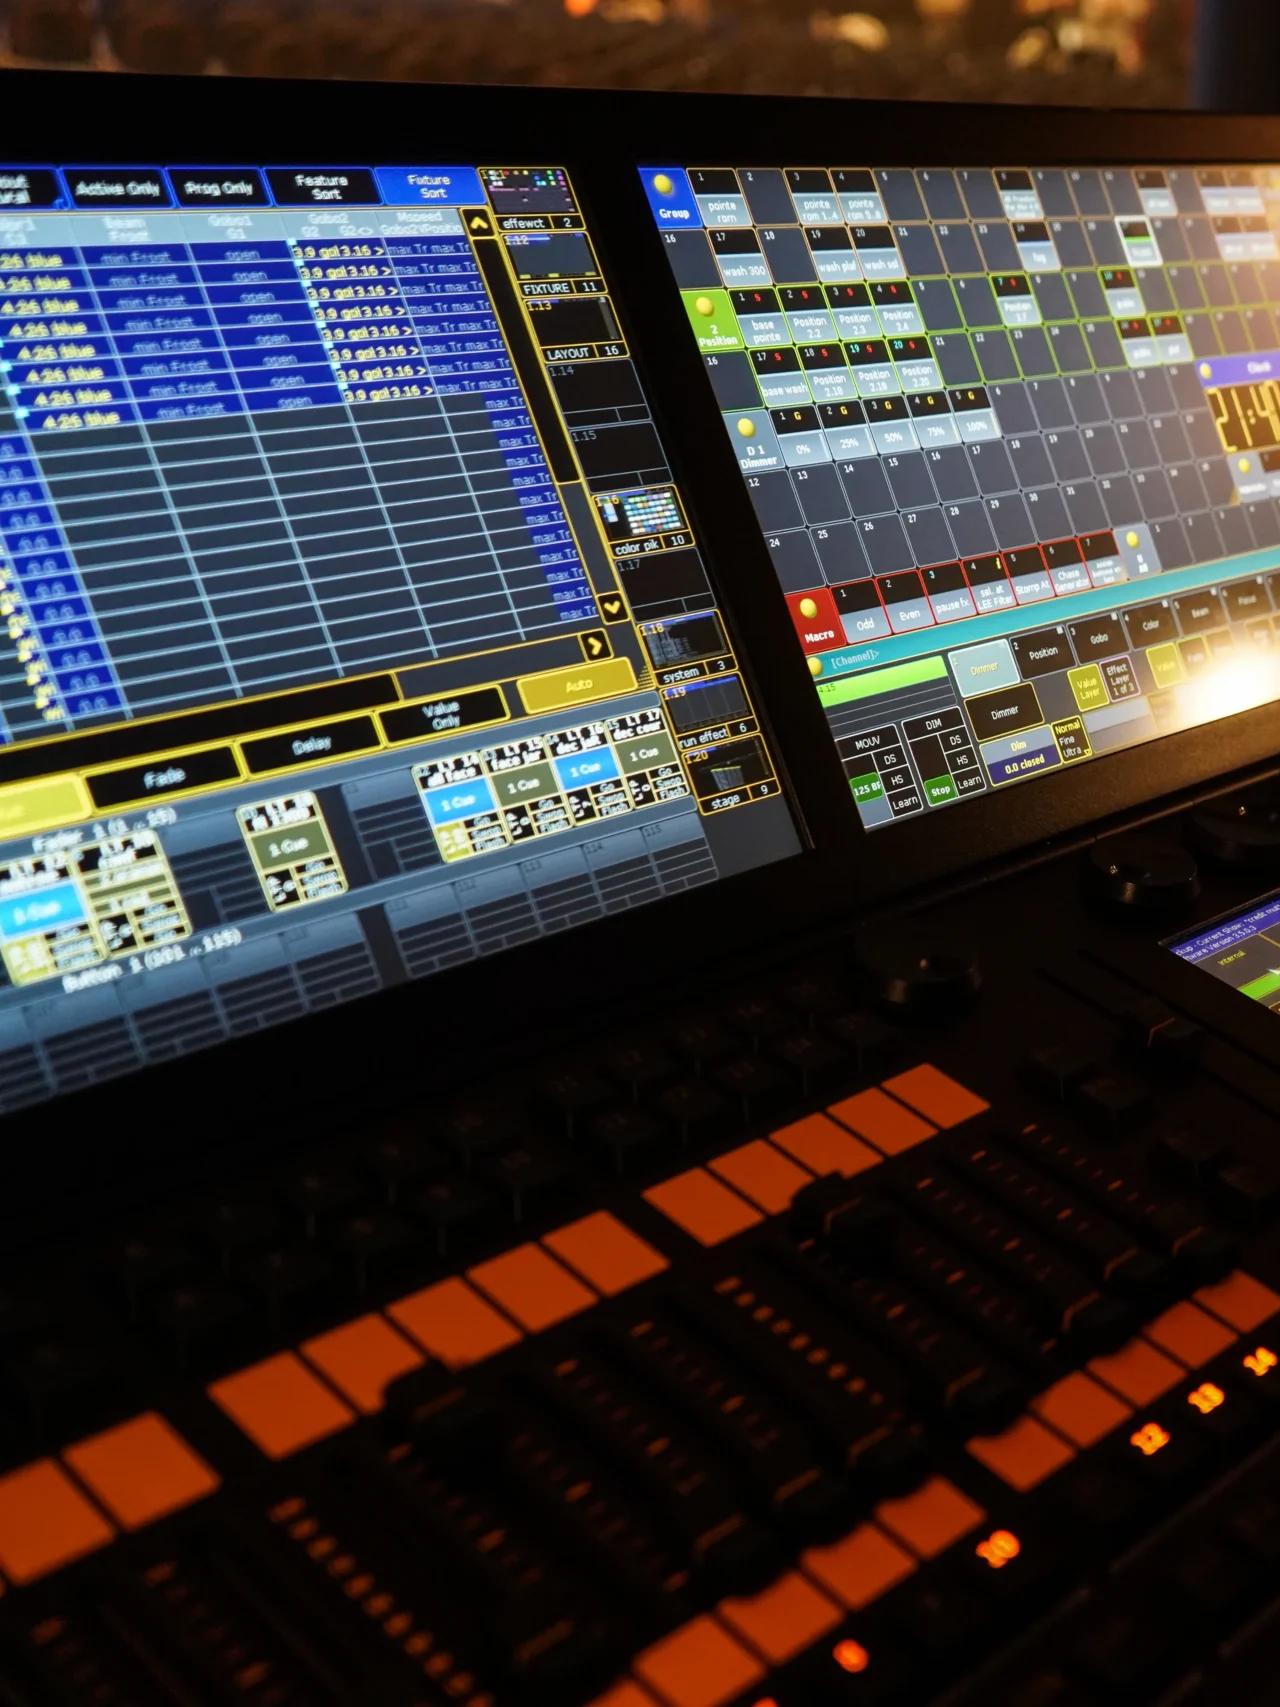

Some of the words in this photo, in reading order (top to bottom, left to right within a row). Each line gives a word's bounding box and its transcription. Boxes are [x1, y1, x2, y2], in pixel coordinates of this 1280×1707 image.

[295, 174, 348, 187] Feature
[407, 174, 451, 186] Fixture
[76, 180, 125, 196] Active
[126, 181, 160, 197] Only
[184, 181, 221, 196] Prog
[221, 181, 253, 197] Only
[311, 187, 342, 200] Sort
[420, 187, 448, 199] Sort
[708, 201, 737, 213] pointe
[803, 200, 830, 210] pointe
[848, 199, 874, 209] pointe
[659, 208, 690, 220] Group
[717, 214, 737, 223] rom
[802, 212, 819, 222] rom
[847, 210, 864, 220] rom
[503, 218, 546, 230] effewct
[563, 218, 572, 227] 2
[665, 233, 677, 243] 16
[716, 232, 726, 242] 17
[764, 231, 775, 241] 18
[811, 230, 821, 239] 19
[818, 261, 841, 273] wash
[864, 259, 885, 270] wash
[723, 266, 747, 277] wash
[748, 265, 766, 276] 300
[523, 283, 570, 295] FIXTURE
[582, 282, 598, 292] 11
[527, 300, 552, 311] 1.13
[1003, 301, 1032, 313] Position
[839, 312, 872, 324] Position
[883, 309, 915, 321] Position
[752, 319, 774, 330] base
[793, 316, 827, 328] Position
[895, 322, 910, 332] 2.4
[711, 324, 718, 334] 2
[806, 329, 822, 339] 2.2
[698, 335, 738, 347] Position
[753, 331, 781, 344] pointe
[547, 347, 589, 361] LAYOUT
[604, 345, 619, 356] 16
[550, 365, 574, 377] 1.14
[858, 369, 891, 381] Position
[902, 365, 933, 377] Position
[813, 374, 846, 385] Position
[911, 377, 930, 387] 2.20
[763, 385, 784, 397] base
[786, 382, 808, 394] wash
[824, 387, 843, 397] 2.18
[927, 426, 945, 438] 75%
[966, 420, 988, 432] 100%
[572, 430, 597, 442] 1.15
[884, 432, 903, 443] 50%
[796, 444, 811, 455] 0%
[839, 438, 859, 449] 25%
[741, 456, 777, 470] Dimmer
[670, 535, 685, 546] 10
[615, 543, 640, 556] color
[643, 540, 660, 552] pik
[617, 559, 641, 572] 1.17
[1058, 568, 1080, 581] Chase
[980, 588, 995, 598] sel.
[995, 585, 1004, 594] at
[1015, 583, 1039, 597] Stomp
[1055, 578, 1090, 593] Generator
[935, 601, 959, 615] pause
[959, 598, 970, 609] fx
[977, 600, 993, 611] LEE
[993, 595, 1013, 607] Filter
[899, 610, 921, 622] Even
[640, 623, 664, 636] 1.18
[857, 618, 875, 631] Odd
[804, 631, 835, 643] Macro
[1090, 633, 1109, 644] Gobo
[1029, 646, 1059, 660] Position
[717, 661, 726, 671] 3
[970, 661, 999, 676] Dimmer
[1106, 664, 1128, 676] Effect
[663, 668, 700, 684] system
[1110, 674, 1129, 686] Layer
[566, 679, 593, 692] Auto
[1077, 676, 1098, 689] Value
[664, 687, 687, 700] 1.19
[1080, 687, 1100, 701] Layer
[422, 702, 460, 718] Value
[991, 705, 1019, 720] Dimmer
[432, 715, 461, 731] Only
[739, 723, 747, 733] 6
[925, 718, 943, 730] DIM
[1055, 719, 1081, 734] Normal
[679, 736, 698, 749] run
[700, 727, 728, 744] effect
[855, 736, 881, 750] MOUV
[949, 735, 962, 745] DS
[1059, 736, 1075, 747] Fine
[291, 736, 332, 755] Delay
[1010, 740, 1027, 751] Dim
[639, 748, 659, 759] Cue
[685, 750, 709, 764] 1.20
[1063, 746, 1082, 758] Ultra
[884, 754, 897, 765] DS
[956, 755, 969, 765] HS
[1005, 762, 1019, 774] 0.0
[1020, 754, 1046, 770] closed
[580, 762, 600, 774] Cue
[517, 778, 540, 791] Cue
[891, 775, 904, 785] HS
[958, 775, 982, 789] Learn
[659, 787, 686, 799] Flash
[760, 785, 769, 795] 9
[853, 786, 869, 797] 125
[931, 786, 951, 797] Stop
[711, 794, 741, 810] stage
[893, 795, 918, 810] Learn
[1196, 931, 1222, 946] Current
[1209, 936, 1233, 951] Version
[1218, 949, 1246, 966] Internal
[1243, 1346, 1279, 1377] 14
